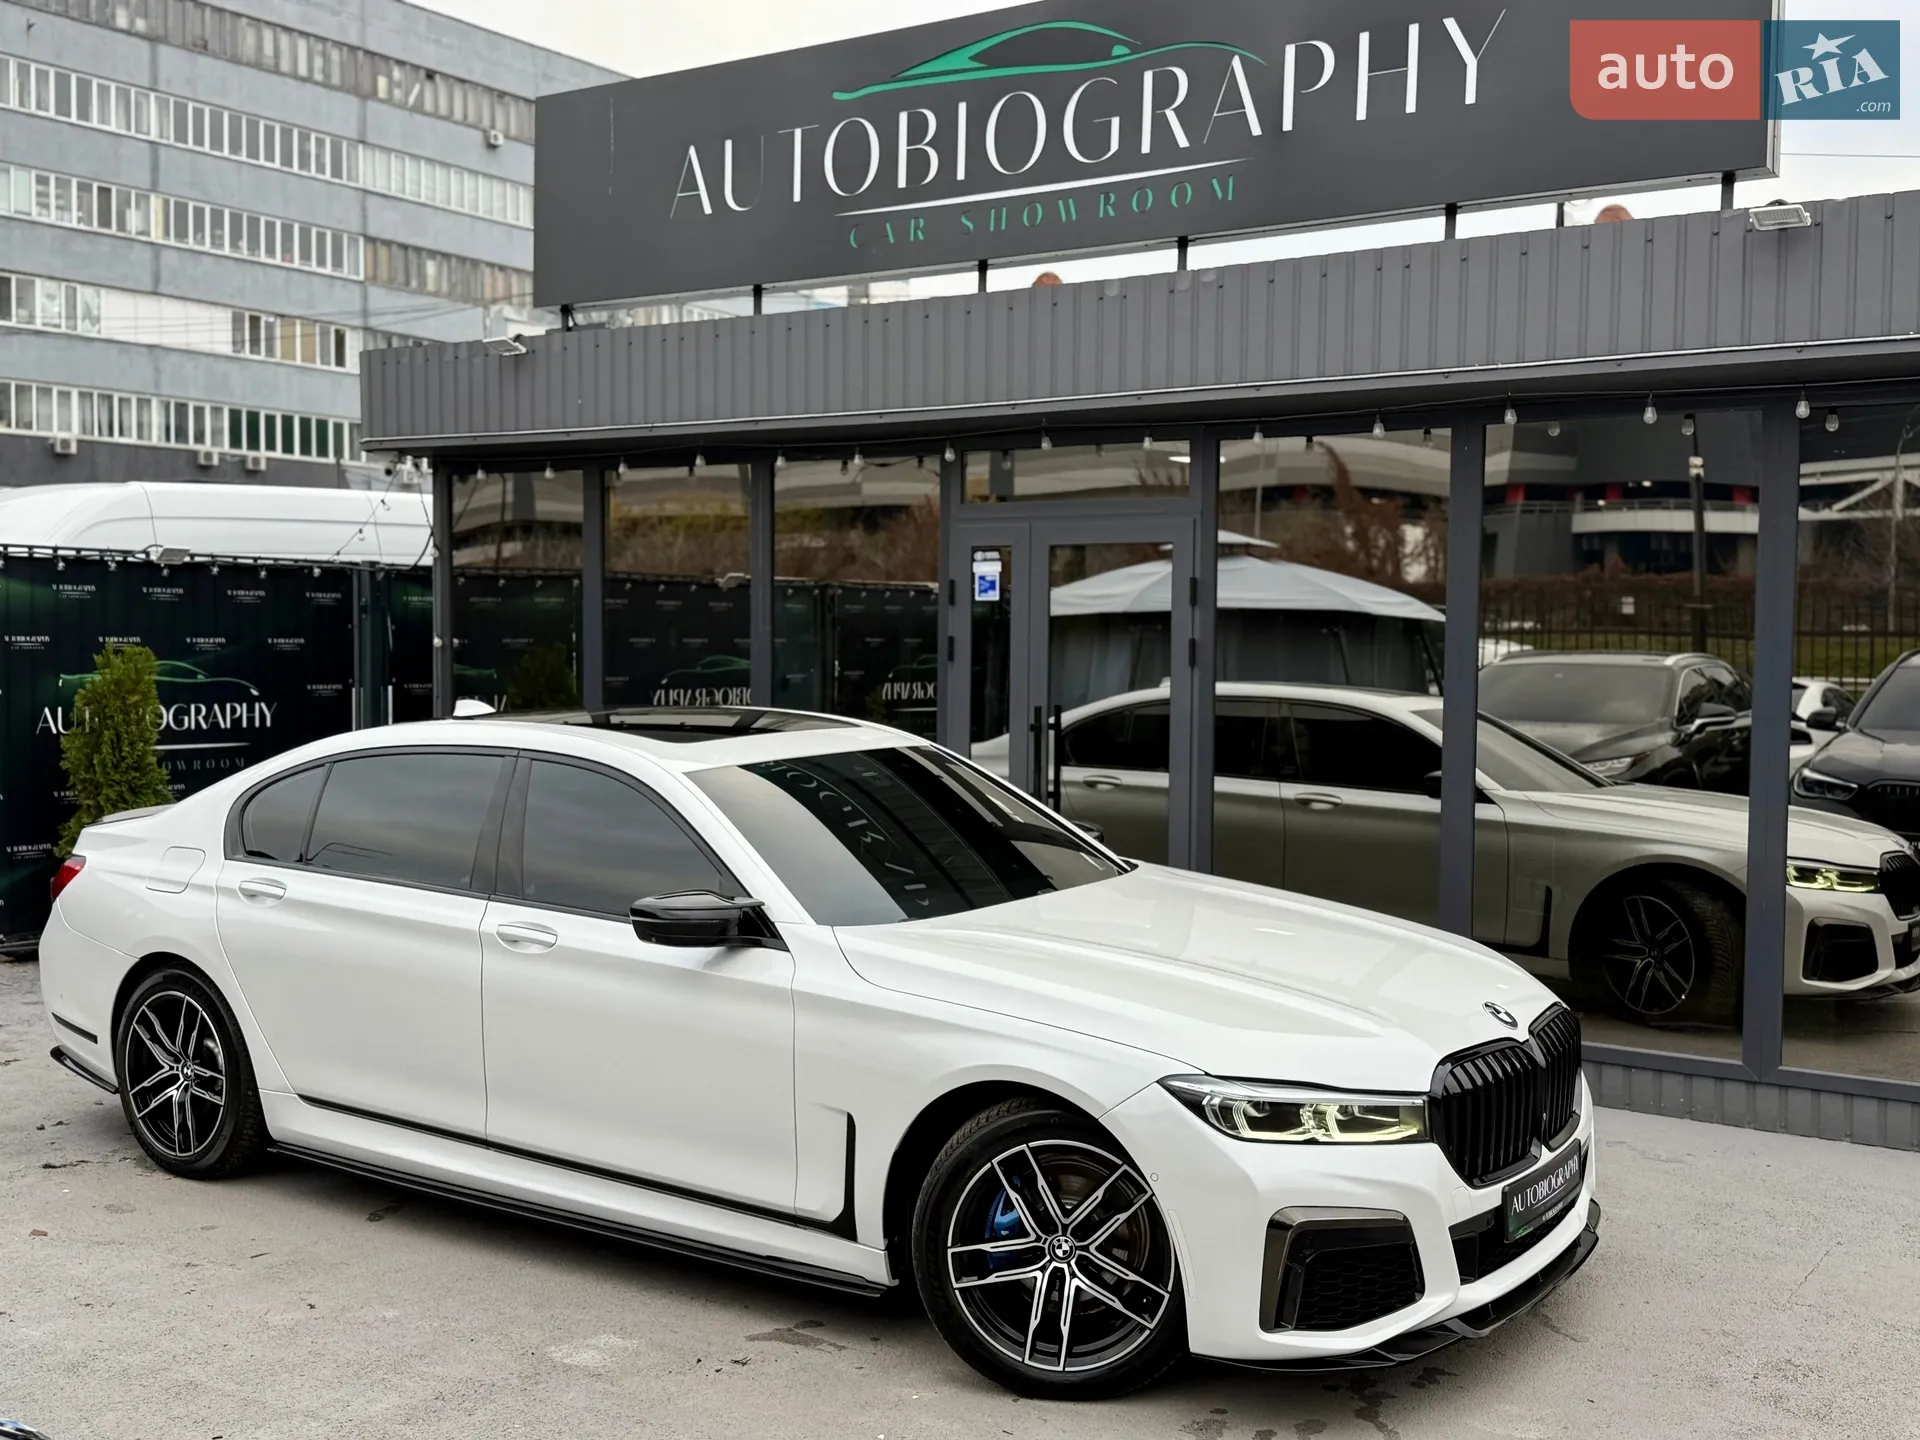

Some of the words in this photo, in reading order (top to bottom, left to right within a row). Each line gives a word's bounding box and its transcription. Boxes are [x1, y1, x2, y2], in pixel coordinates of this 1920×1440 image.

[669, 8, 1507, 219] AUTOBIOGRAPHY
[849, 216, 926, 249] CAR
[960, 174, 1236, 236] SHOWROOM
[36, 701, 277, 735] AUTOGRAPHY
